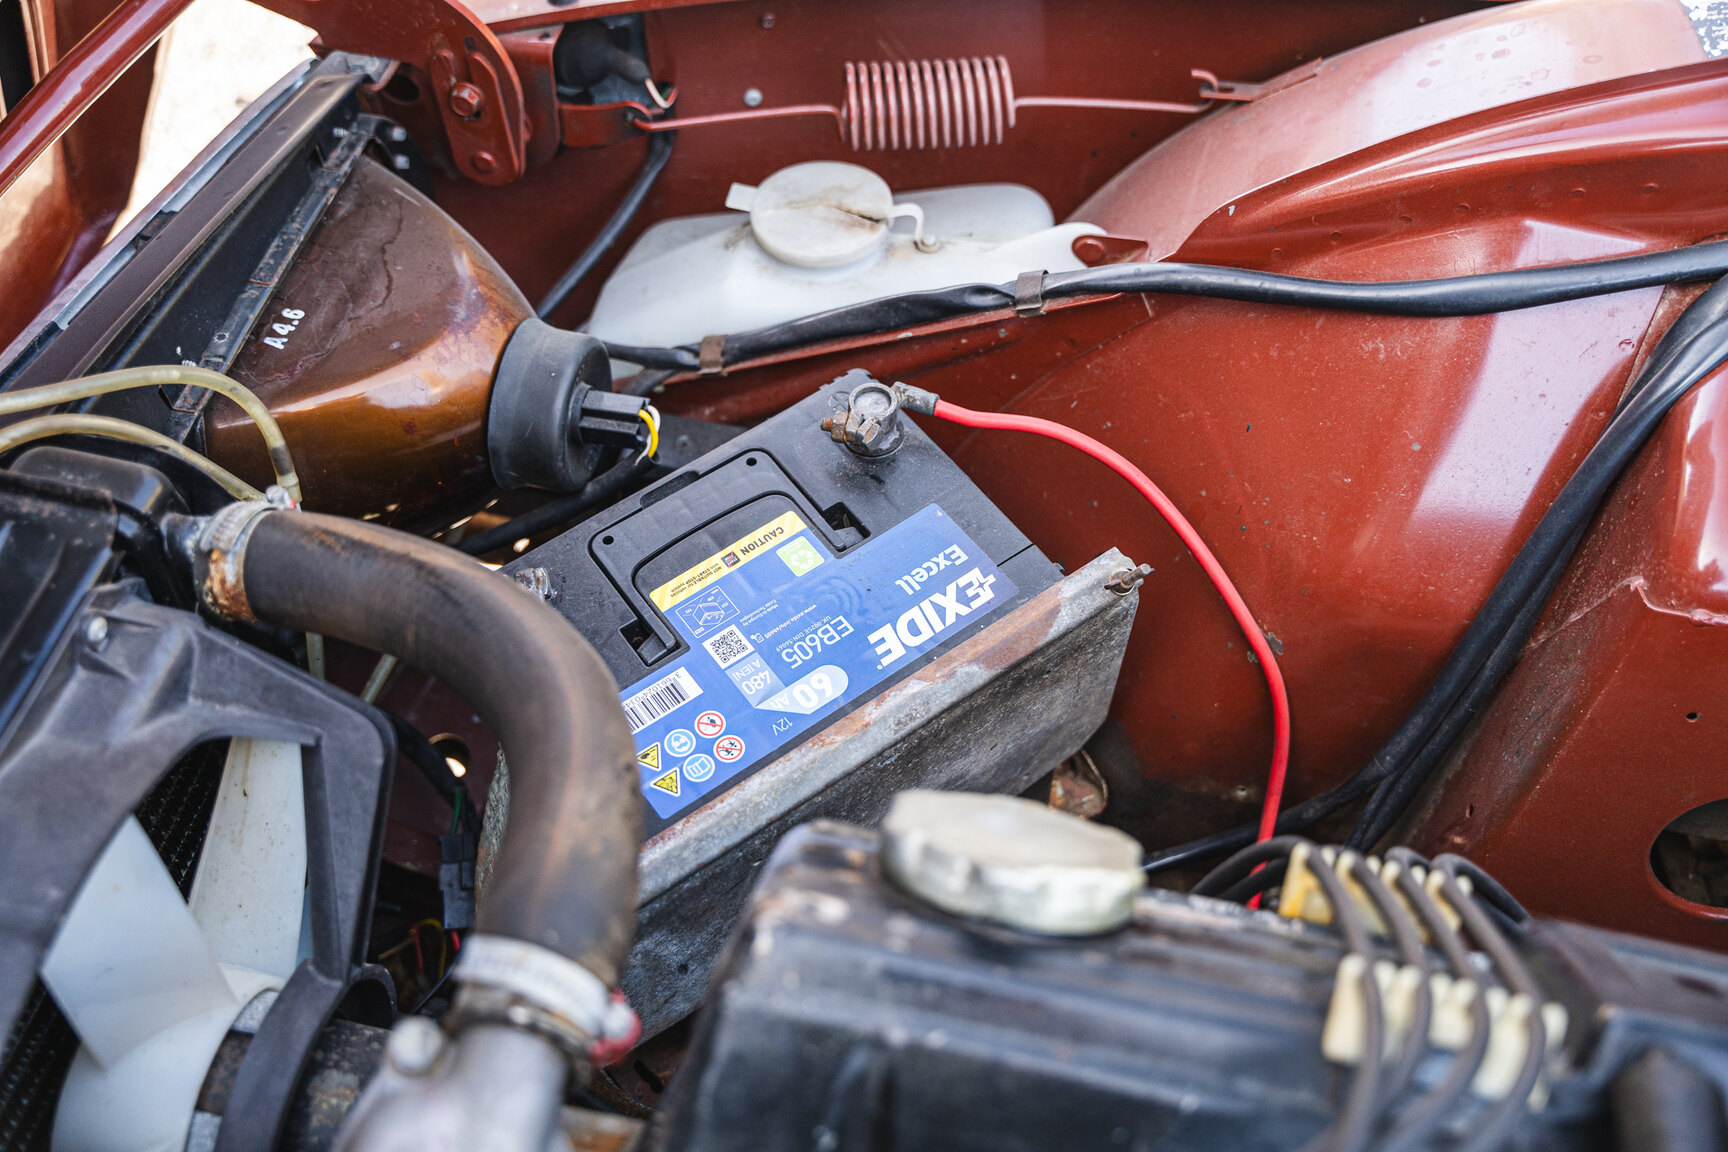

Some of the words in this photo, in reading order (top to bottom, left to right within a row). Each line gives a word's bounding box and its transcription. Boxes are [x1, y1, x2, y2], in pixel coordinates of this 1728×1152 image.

[263, 307, 306, 350] A4.6
[739, 525, 784, 556] CAUTION
[894, 543, 969, 596] Excell
[865, 566, 996, 667] EXIDE
[782, 614, 854, 669] EB605
[674, 670, 682, 679] 3
[731, 662, 754, 681] (EN)
[750, 658, 760, 667] A
[641, 676, 673, 698] 661024
[741, 671, 770, 695] 480
[794, 670, 832, 710] 60
[769, 692, 790, 710] Ah
[771, 716, 793, 735] 12V
